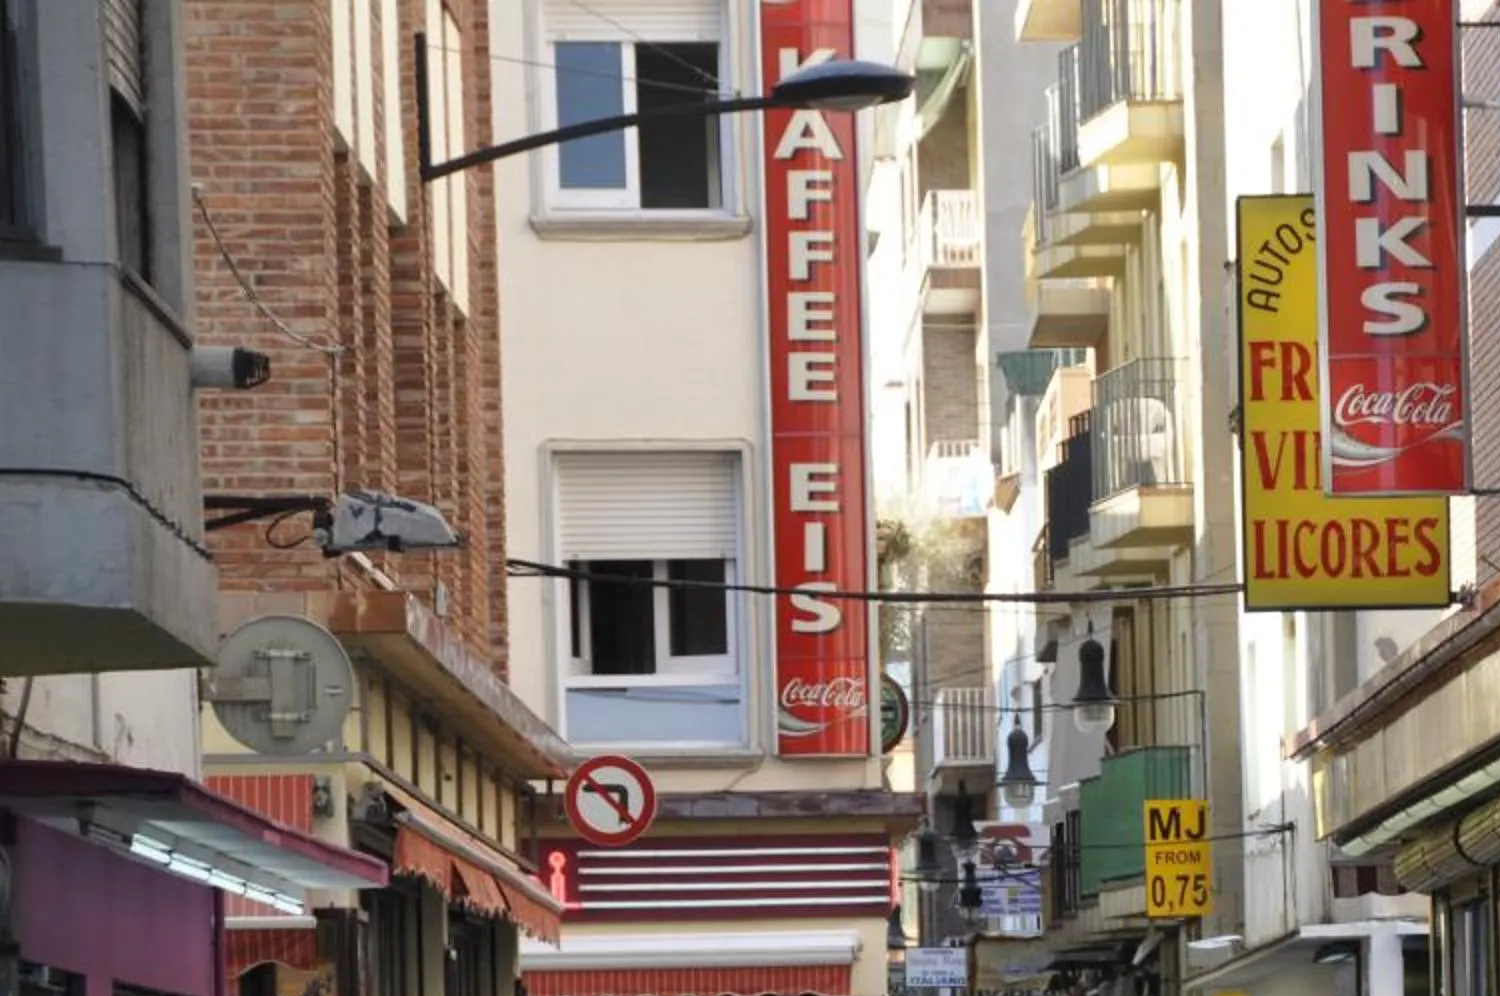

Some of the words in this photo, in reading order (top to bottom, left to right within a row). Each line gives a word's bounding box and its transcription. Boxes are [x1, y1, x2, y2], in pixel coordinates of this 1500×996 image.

[1347, 0, 1433, 334] RINKS
[1248, 340, 1318, 402] FR
[789, 463, 841, 635] EIS
[1252, 517, 1441, 580] LICORES
[1149, 806, 1206, 840] MJ
[1155, 851, 1201, 864] FROM
[1152, 874, 1208, 912] 0,75
